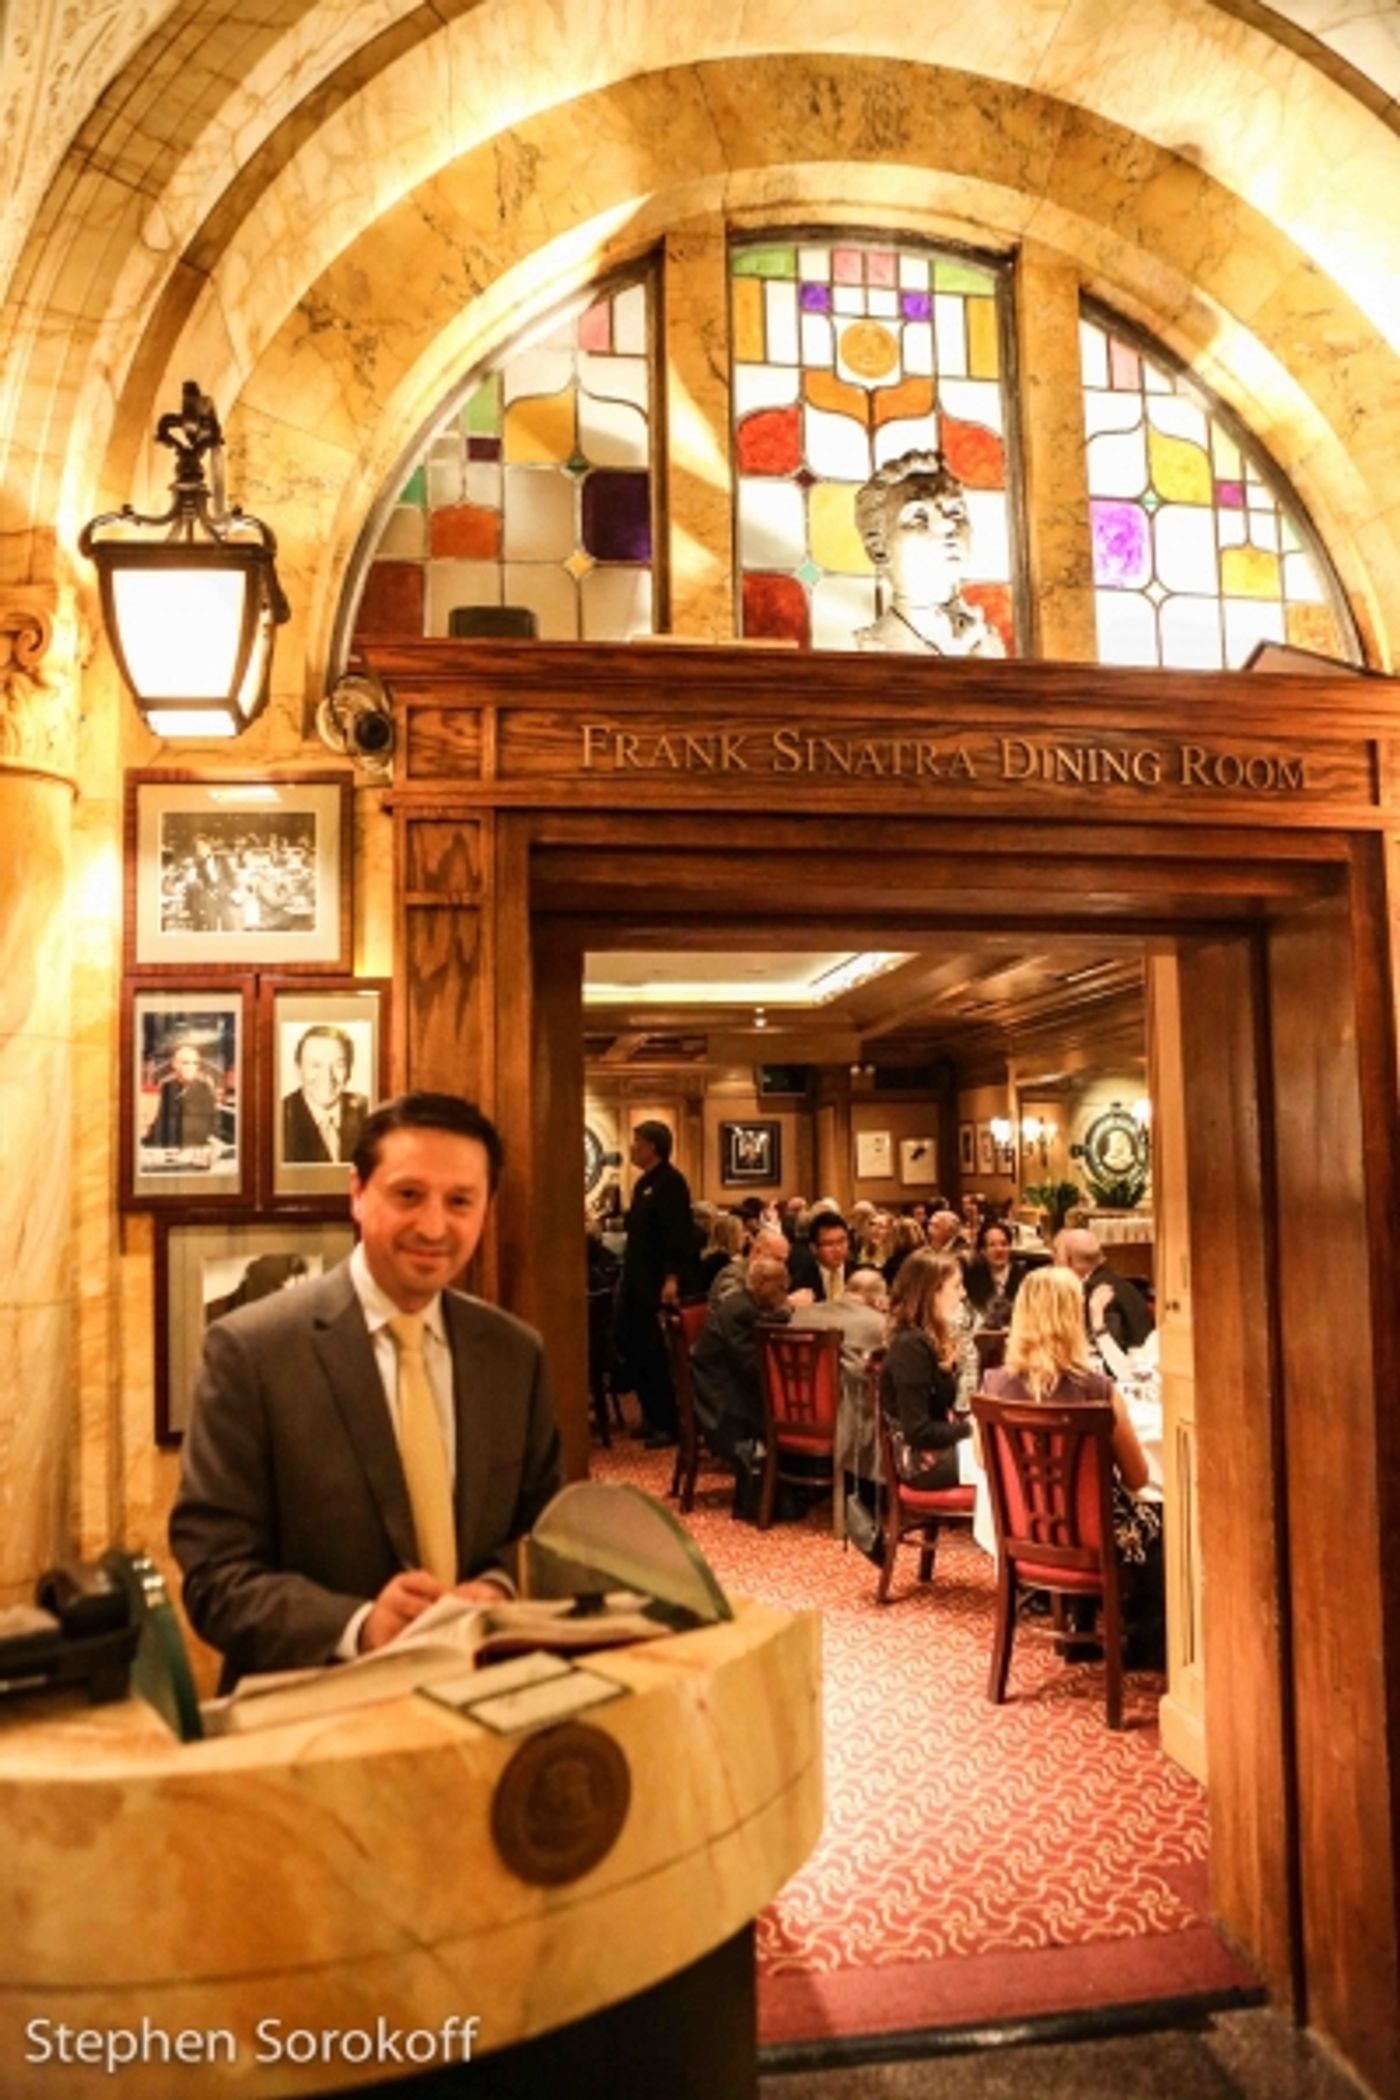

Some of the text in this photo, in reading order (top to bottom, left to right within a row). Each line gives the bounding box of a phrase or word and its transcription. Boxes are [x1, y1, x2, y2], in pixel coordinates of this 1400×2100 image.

[579, 724, 1306, 790] FRANK SINATRA DINING ROOM
